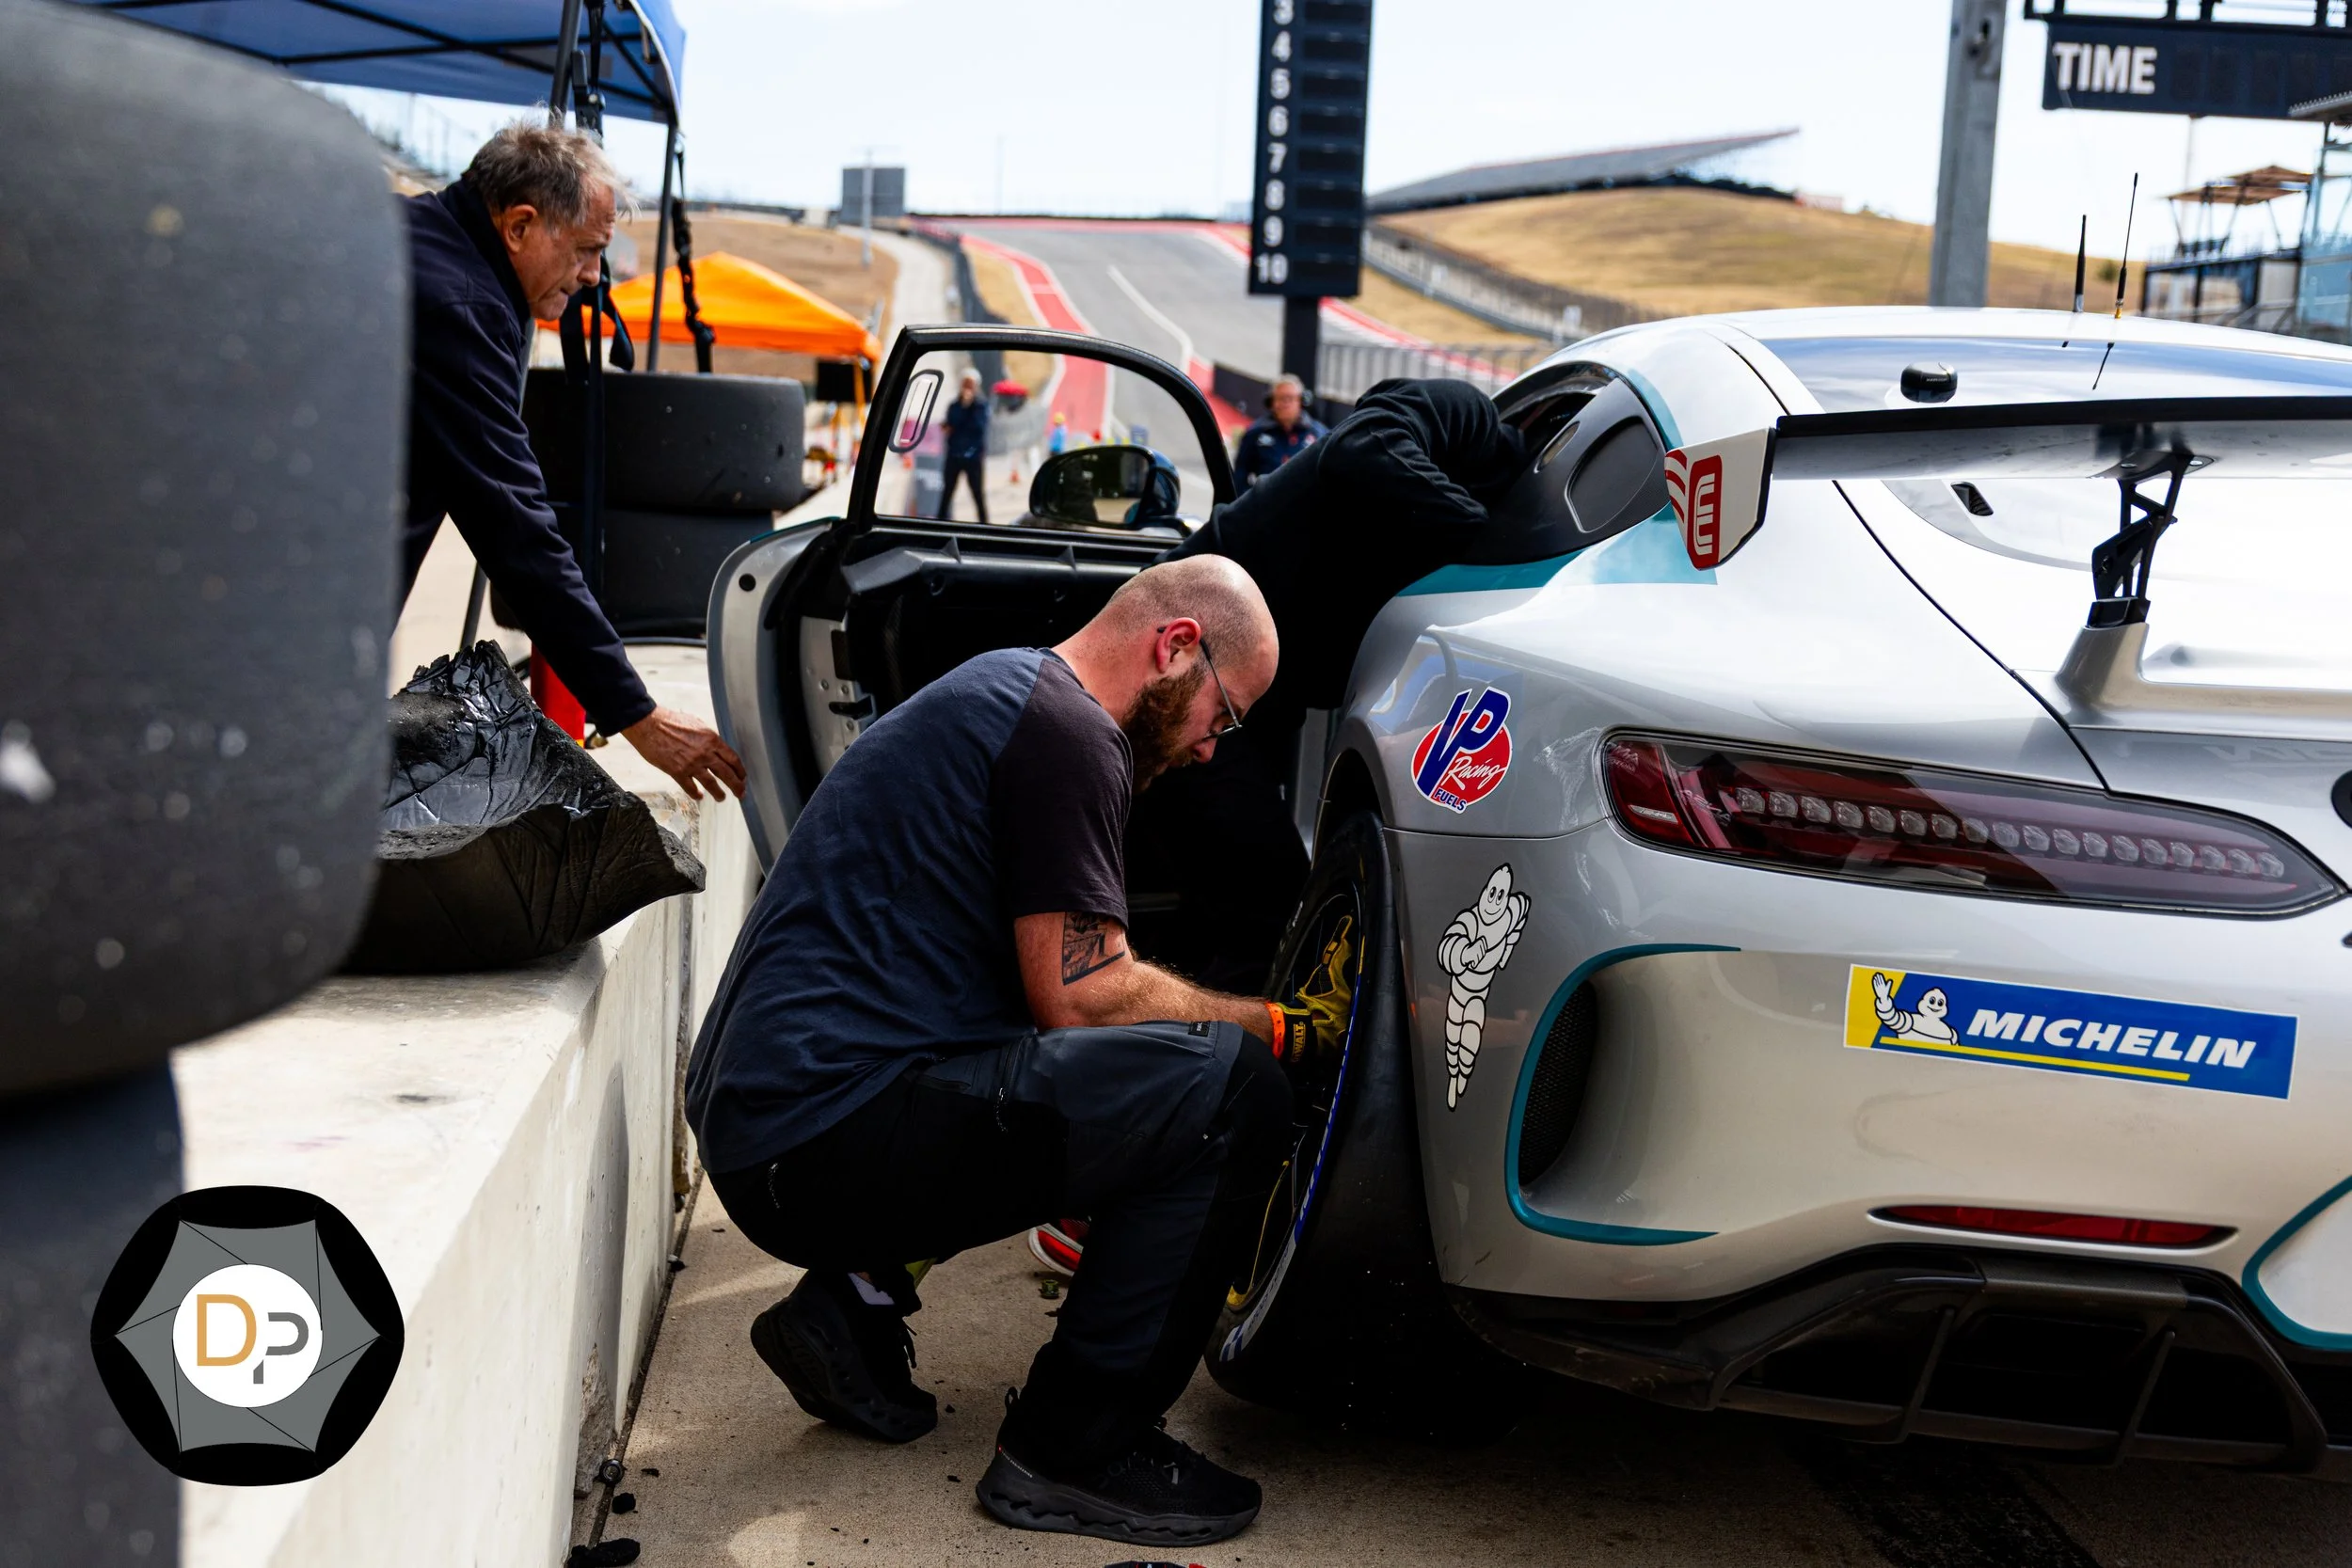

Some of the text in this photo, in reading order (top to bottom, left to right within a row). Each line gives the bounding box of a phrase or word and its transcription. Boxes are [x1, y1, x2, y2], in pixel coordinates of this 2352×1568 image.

[1273, 0, 1295, 24] 3
[1271, 31, 1292, 62] 4
[1270, 69, 1291, 100] 5
[2052, 42, 2157, 95] TIME
[1268, 105, 1289, 137] 6
[1267, 142, 1288, 173] 7
[1264, 179, 1285, 211] 8
[1263, 215, 1283, 247] 9
[1256, 253, 1289, 284] 10
[1415, 688, 1510, 797] VP
[1440, 755, 1507, 791] Racing
[1435, 788, 1468, 812] FUELS
[1966, 1008, 2257, 1069] MICHELIN
